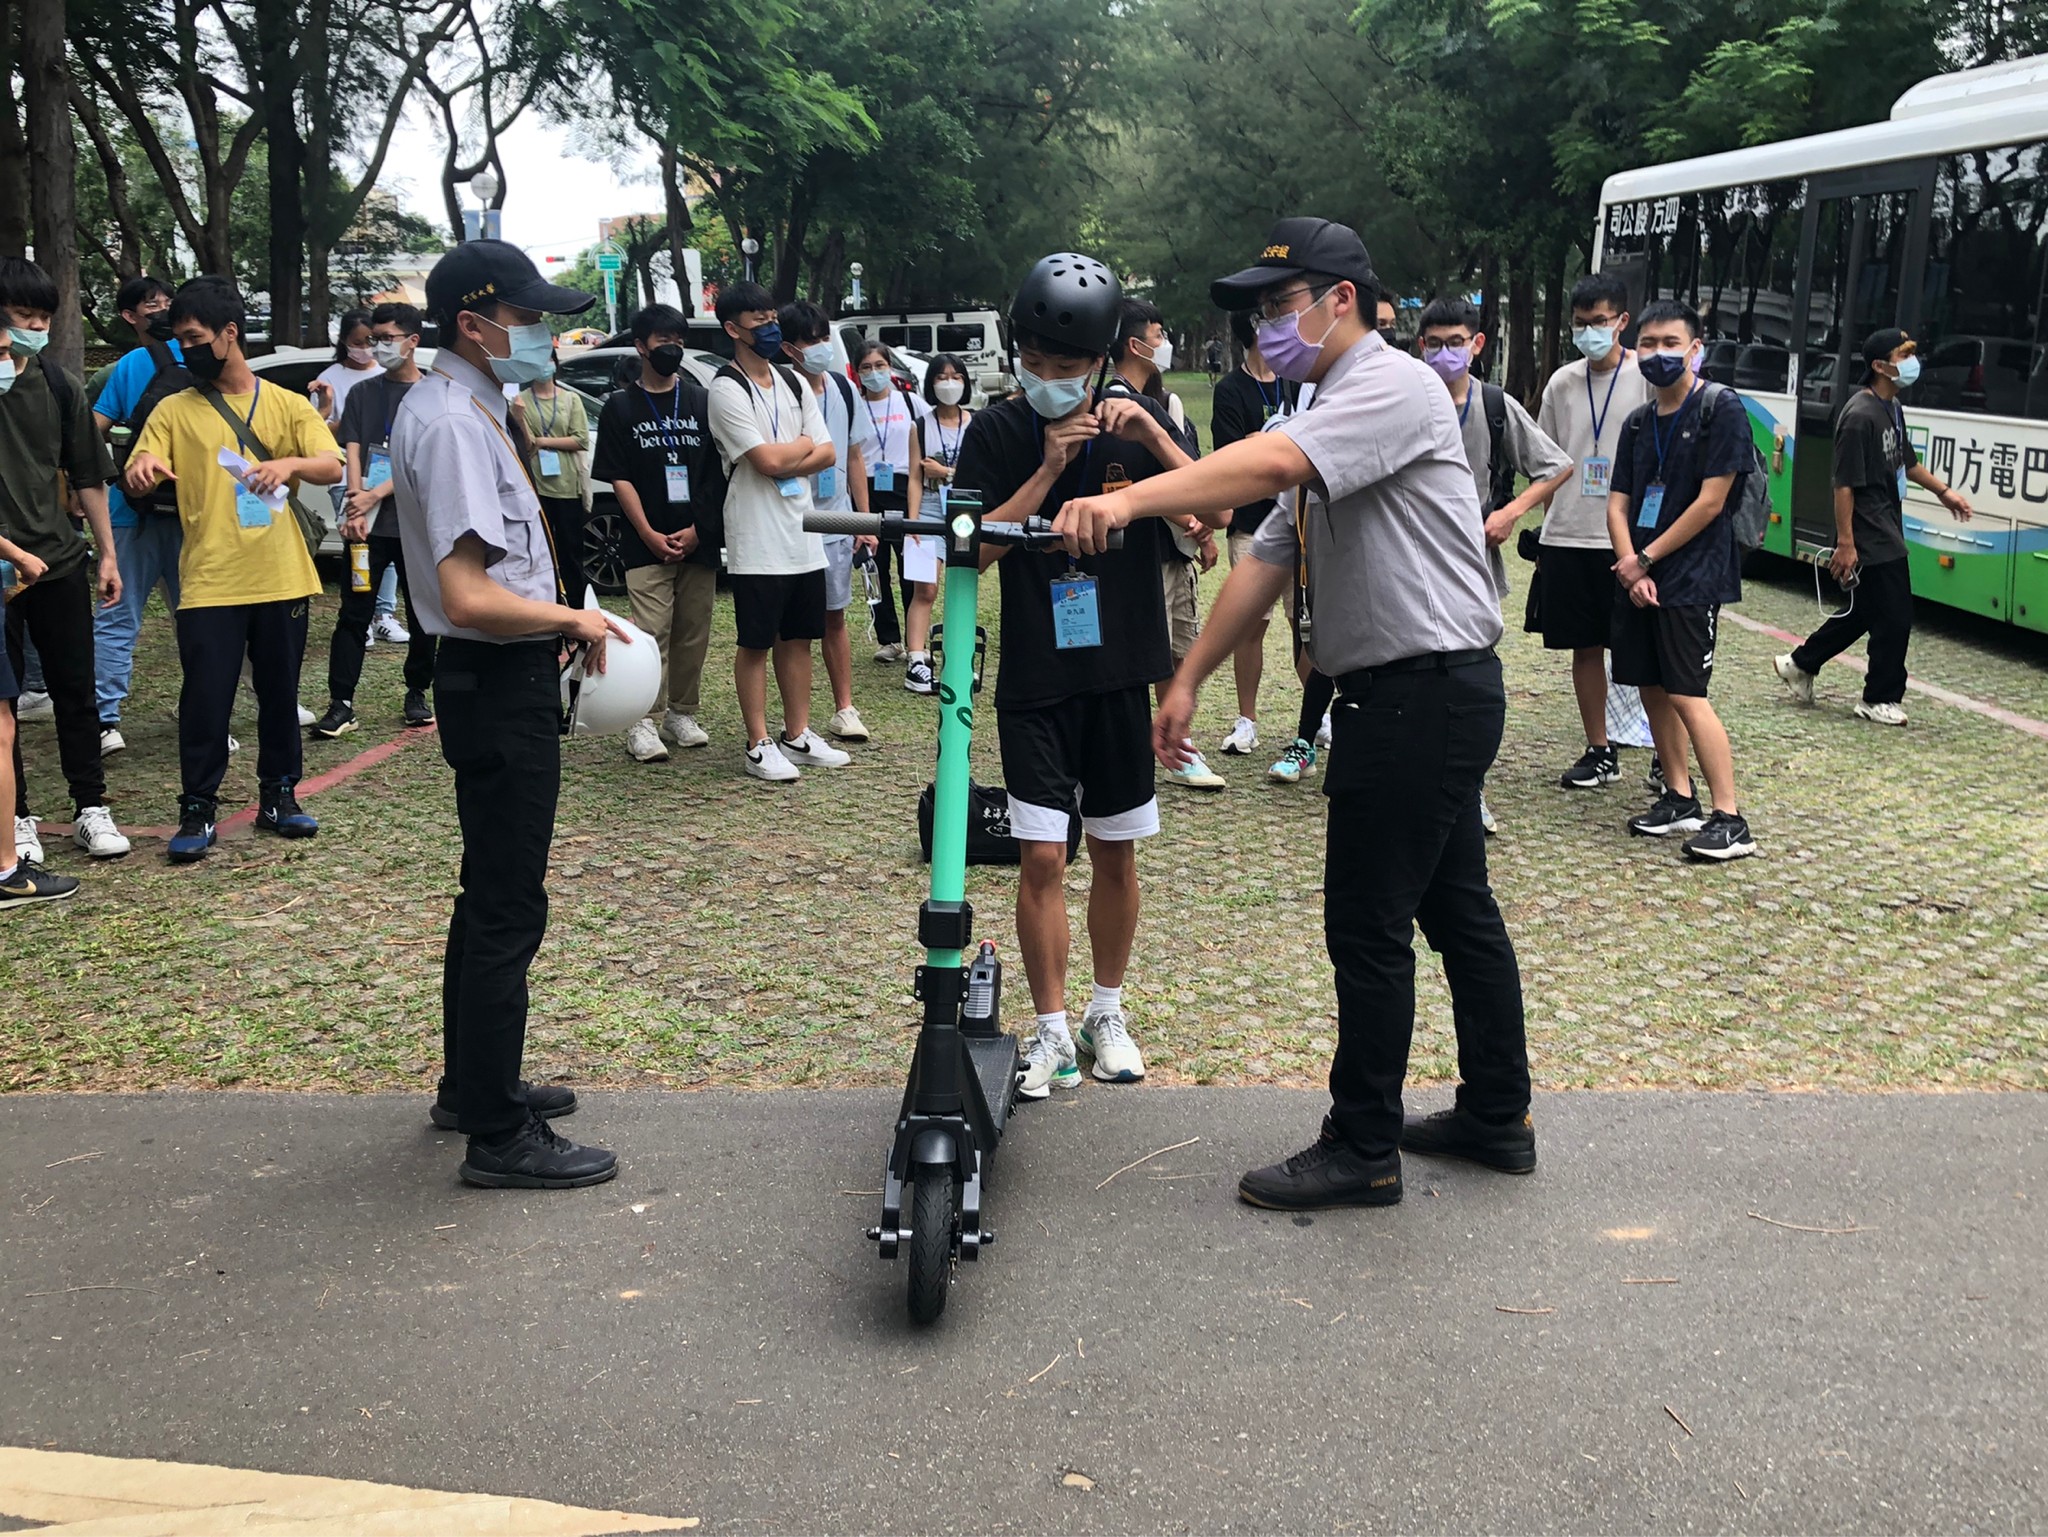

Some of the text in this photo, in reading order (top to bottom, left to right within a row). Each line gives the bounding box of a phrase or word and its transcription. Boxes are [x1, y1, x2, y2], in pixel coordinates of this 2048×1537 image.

[632, 420, 659, 439] you
[639, 434, 661, 449] bet
[681, 434, 701, 447] me
